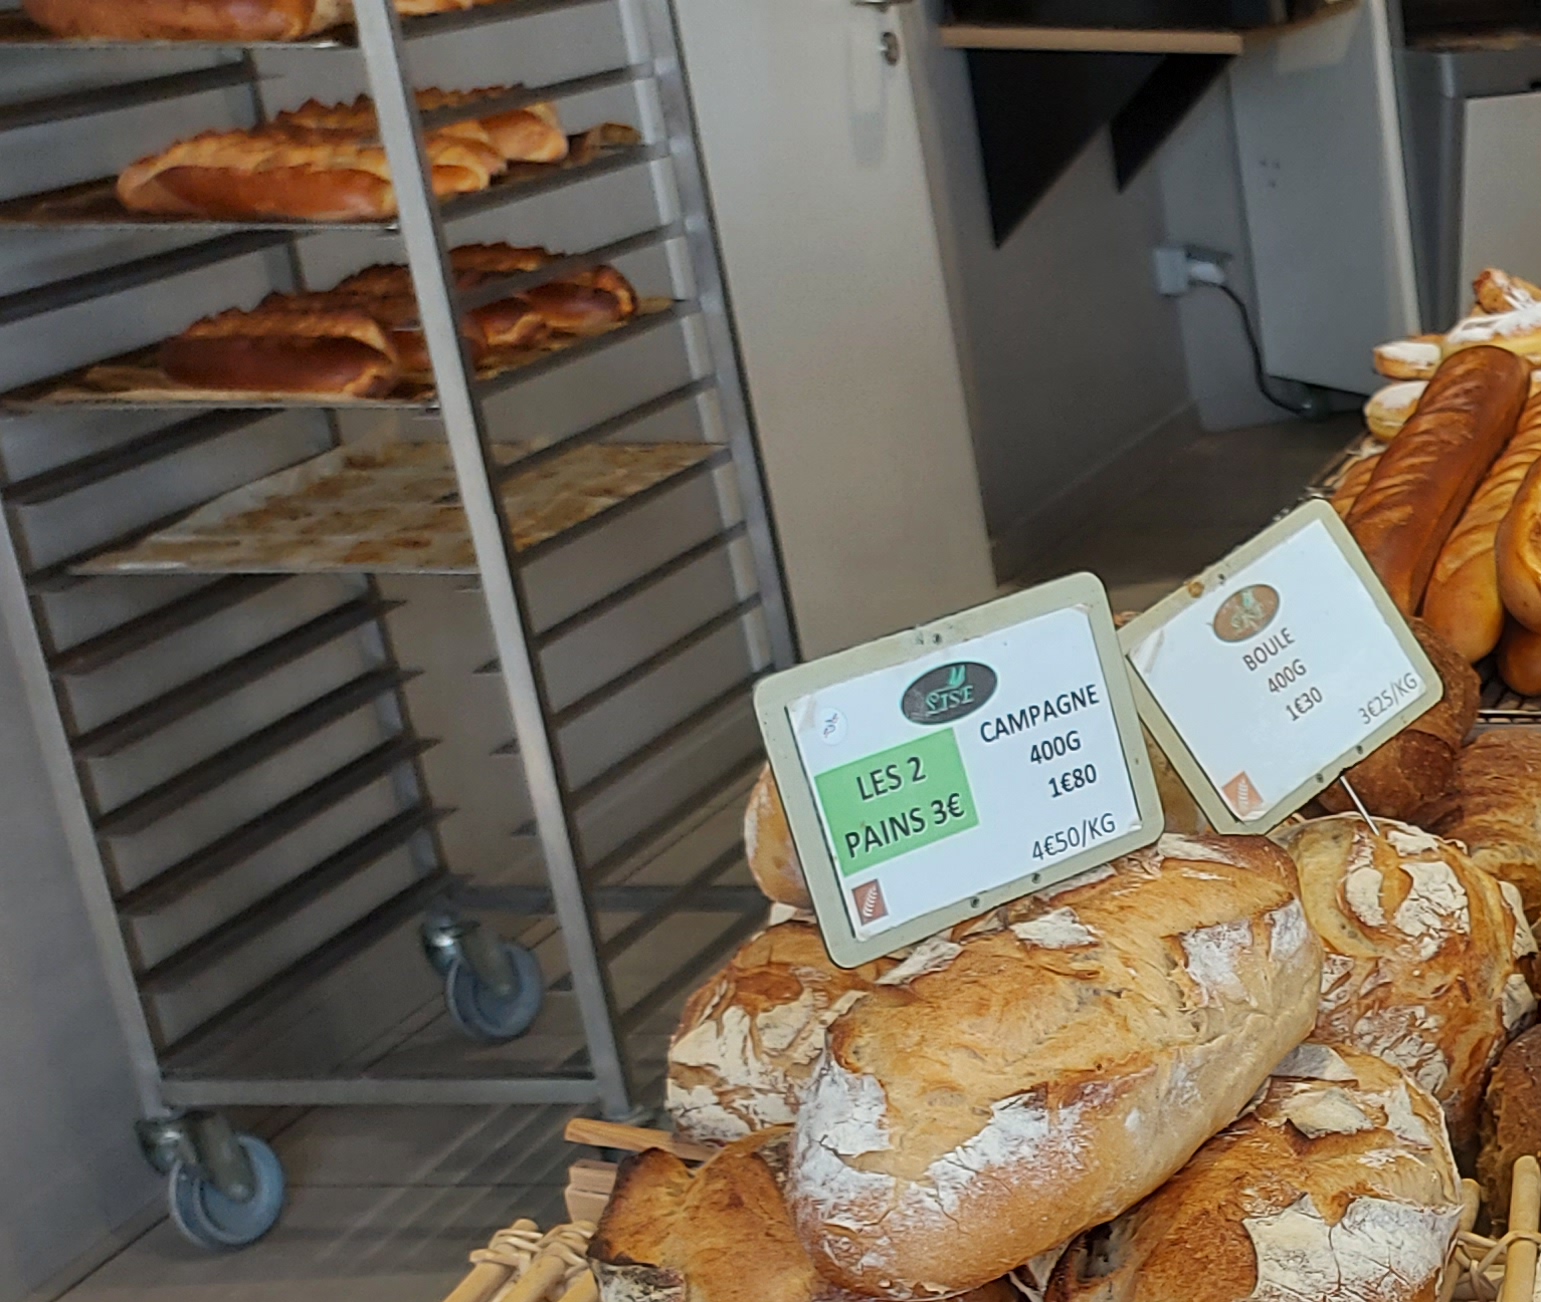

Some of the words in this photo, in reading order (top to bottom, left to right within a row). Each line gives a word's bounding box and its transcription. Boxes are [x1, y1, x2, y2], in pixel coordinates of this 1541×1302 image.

[1243, 627, 1295, 672] BOULE
[1267, 659, 1307, 694] 400G
[1358, 672, 1418, 726] 3€25/KG
[980, 683, 1100, 743] CAMPAGNE
[1286, 686, 1323, 722] 1€30
[1029, 730, 1082, 765] 400G
[856, 765, 902, 801] LES
[907, 756, 927, 785] 2
[1049, 763, 1098, 799] 1€80
[845, 810, 927, 859] PAINS
[930, 793, 965, 827] 3€
[1031, 812, 1117, 862] 4€50/KG
